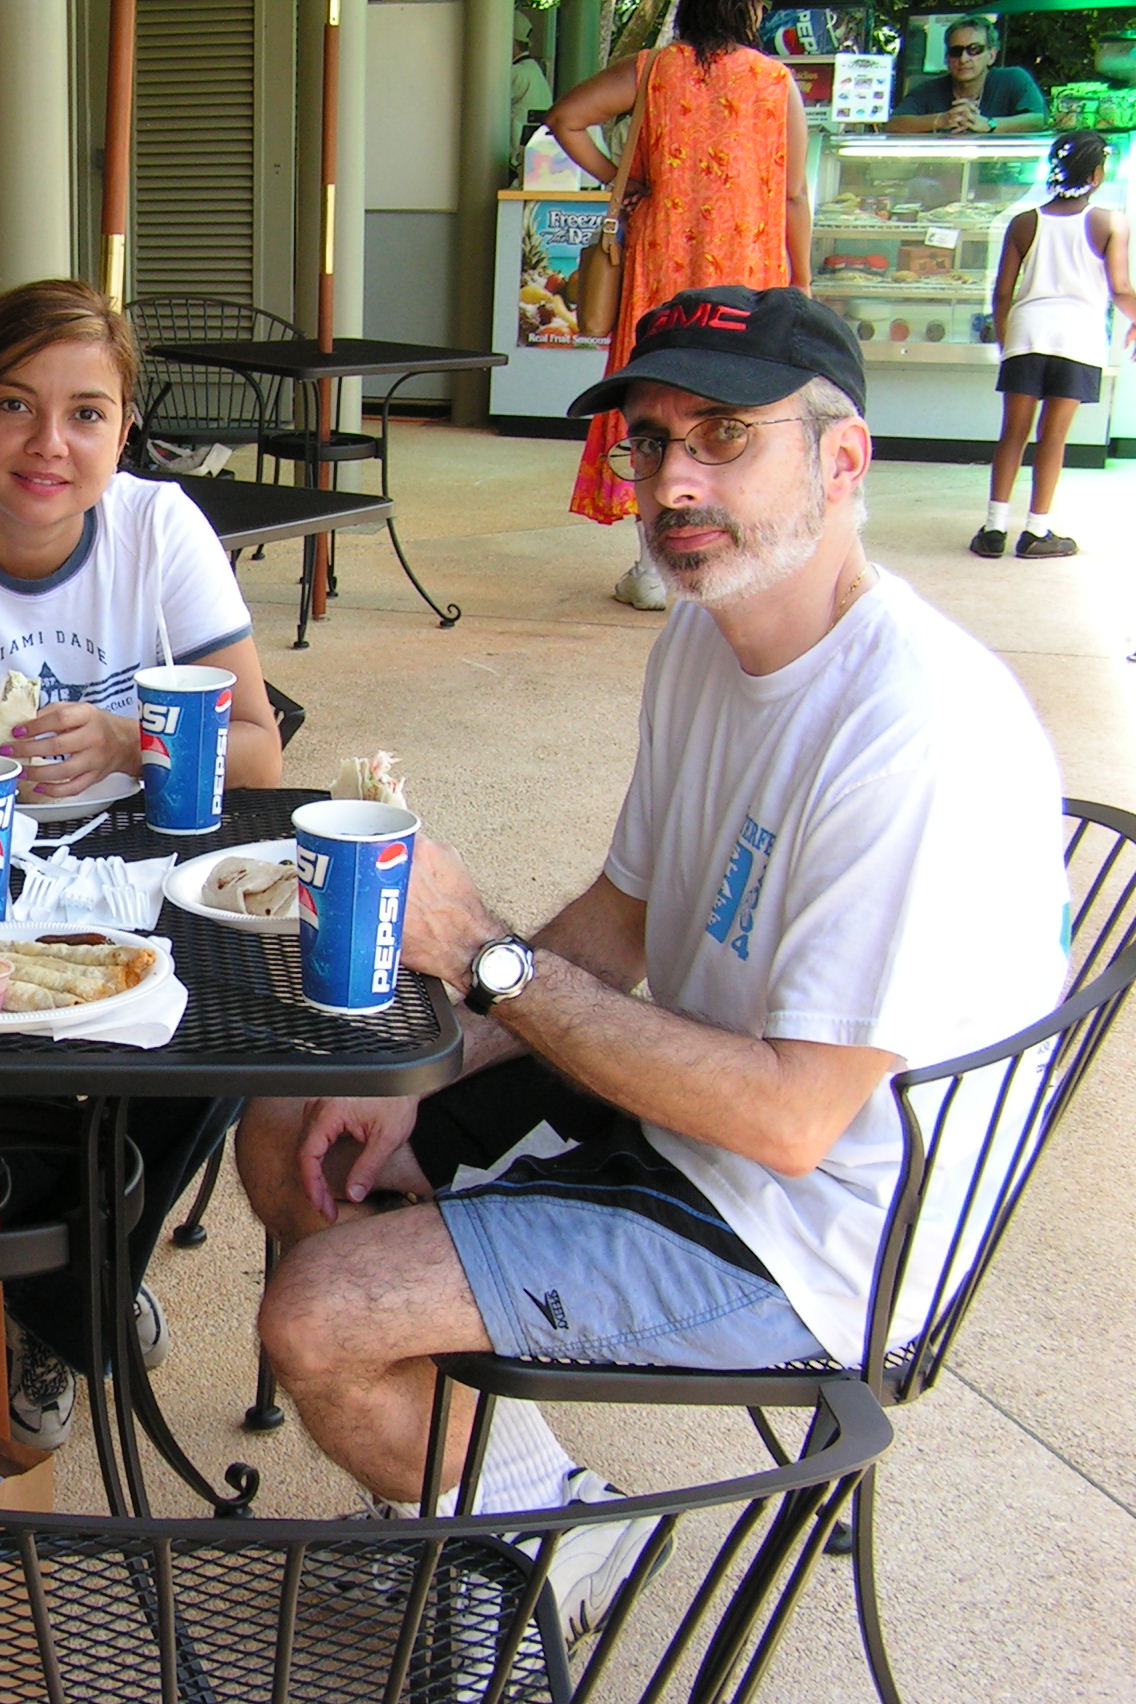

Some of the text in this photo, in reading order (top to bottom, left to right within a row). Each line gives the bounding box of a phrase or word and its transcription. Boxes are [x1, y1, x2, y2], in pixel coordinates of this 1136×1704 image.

[797, 9, 819, 54] PEP
[644, 302, 752, 334] GMC
[528, 333, 548, 343] Real
[550, 333, 570, 345] Fruit
[56, 630, 108, 666] DADE
[212, 728, 229, 815] PEPSI
[372, 888, 401, 994] PEPSI
[547, 1289, 569, 1330] SPEEDO
